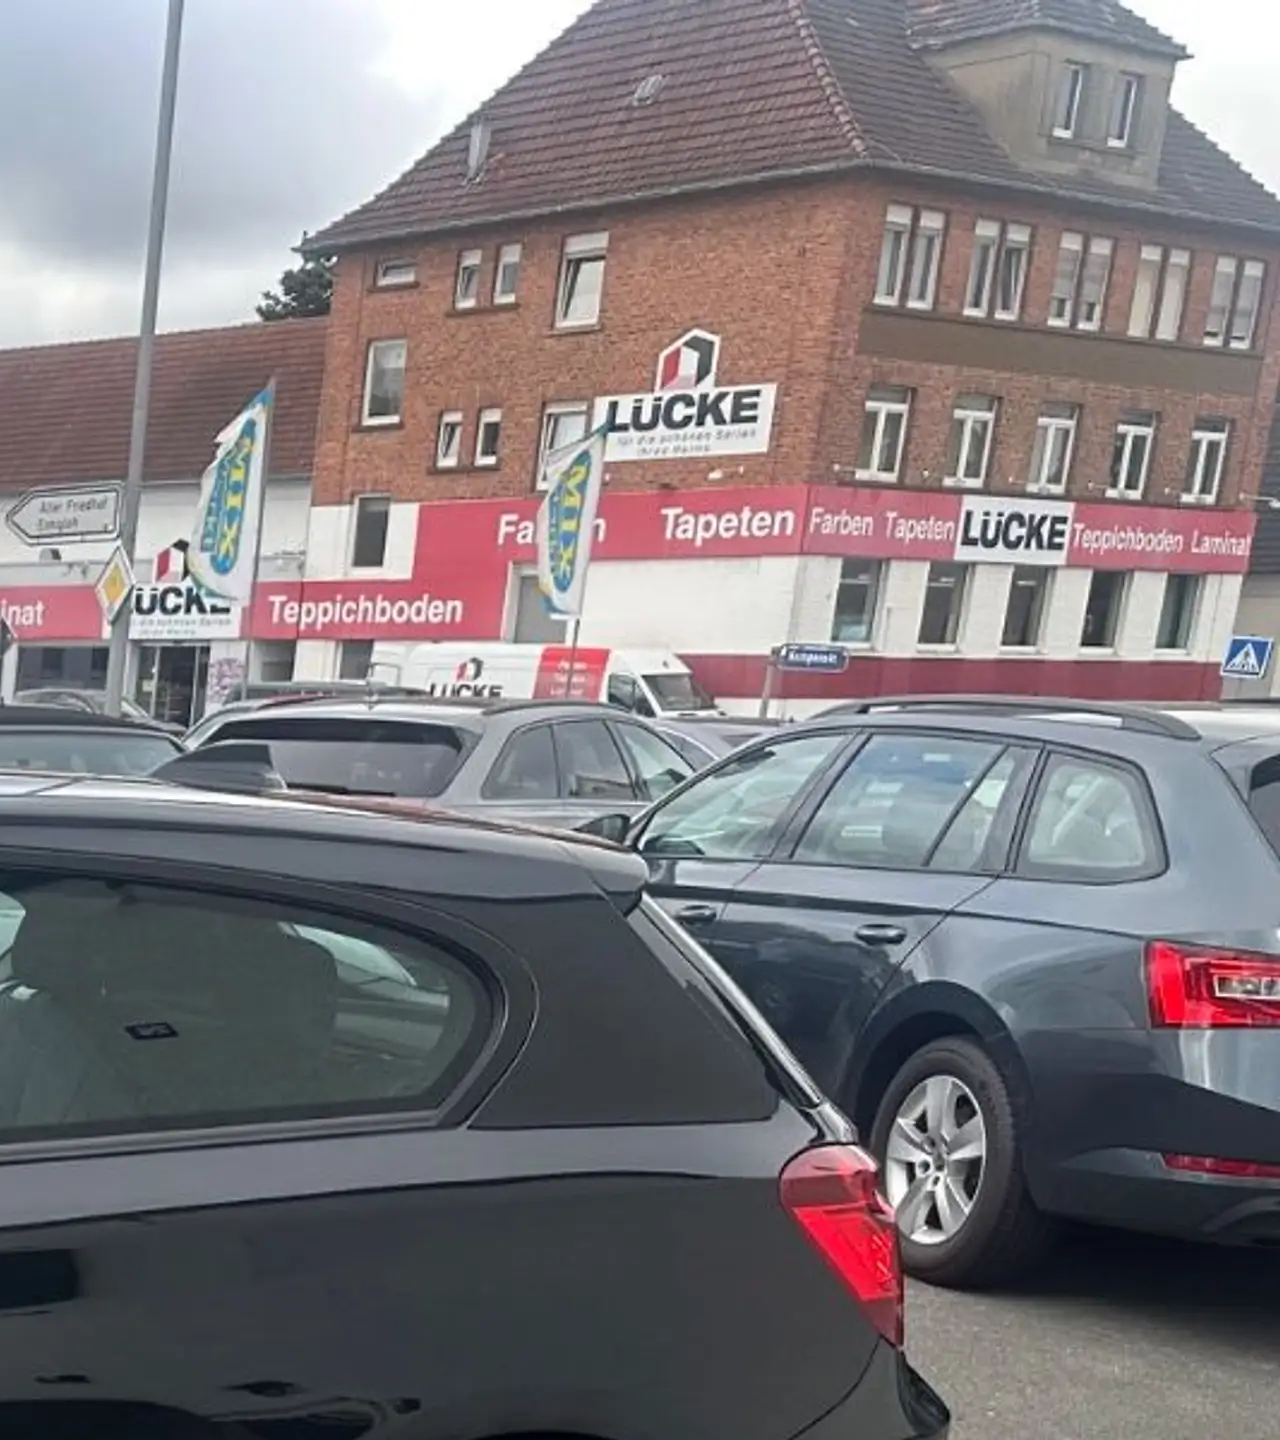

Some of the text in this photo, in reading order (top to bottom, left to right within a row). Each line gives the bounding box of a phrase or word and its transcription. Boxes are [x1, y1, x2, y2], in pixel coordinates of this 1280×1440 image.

[605, 389, 761, 434] LÜCKE
[218, 434, 254, 556] MIX
[661, 506, 795, 547] Tapeten
[809, 507, 956, 542] Farben Tapeten
[960, 510, 1069, 551] LÜCKE
[1072, 522, 1252, 556] Teppichboden Laminat
[268, 594, 464, 630] Teppichboden
